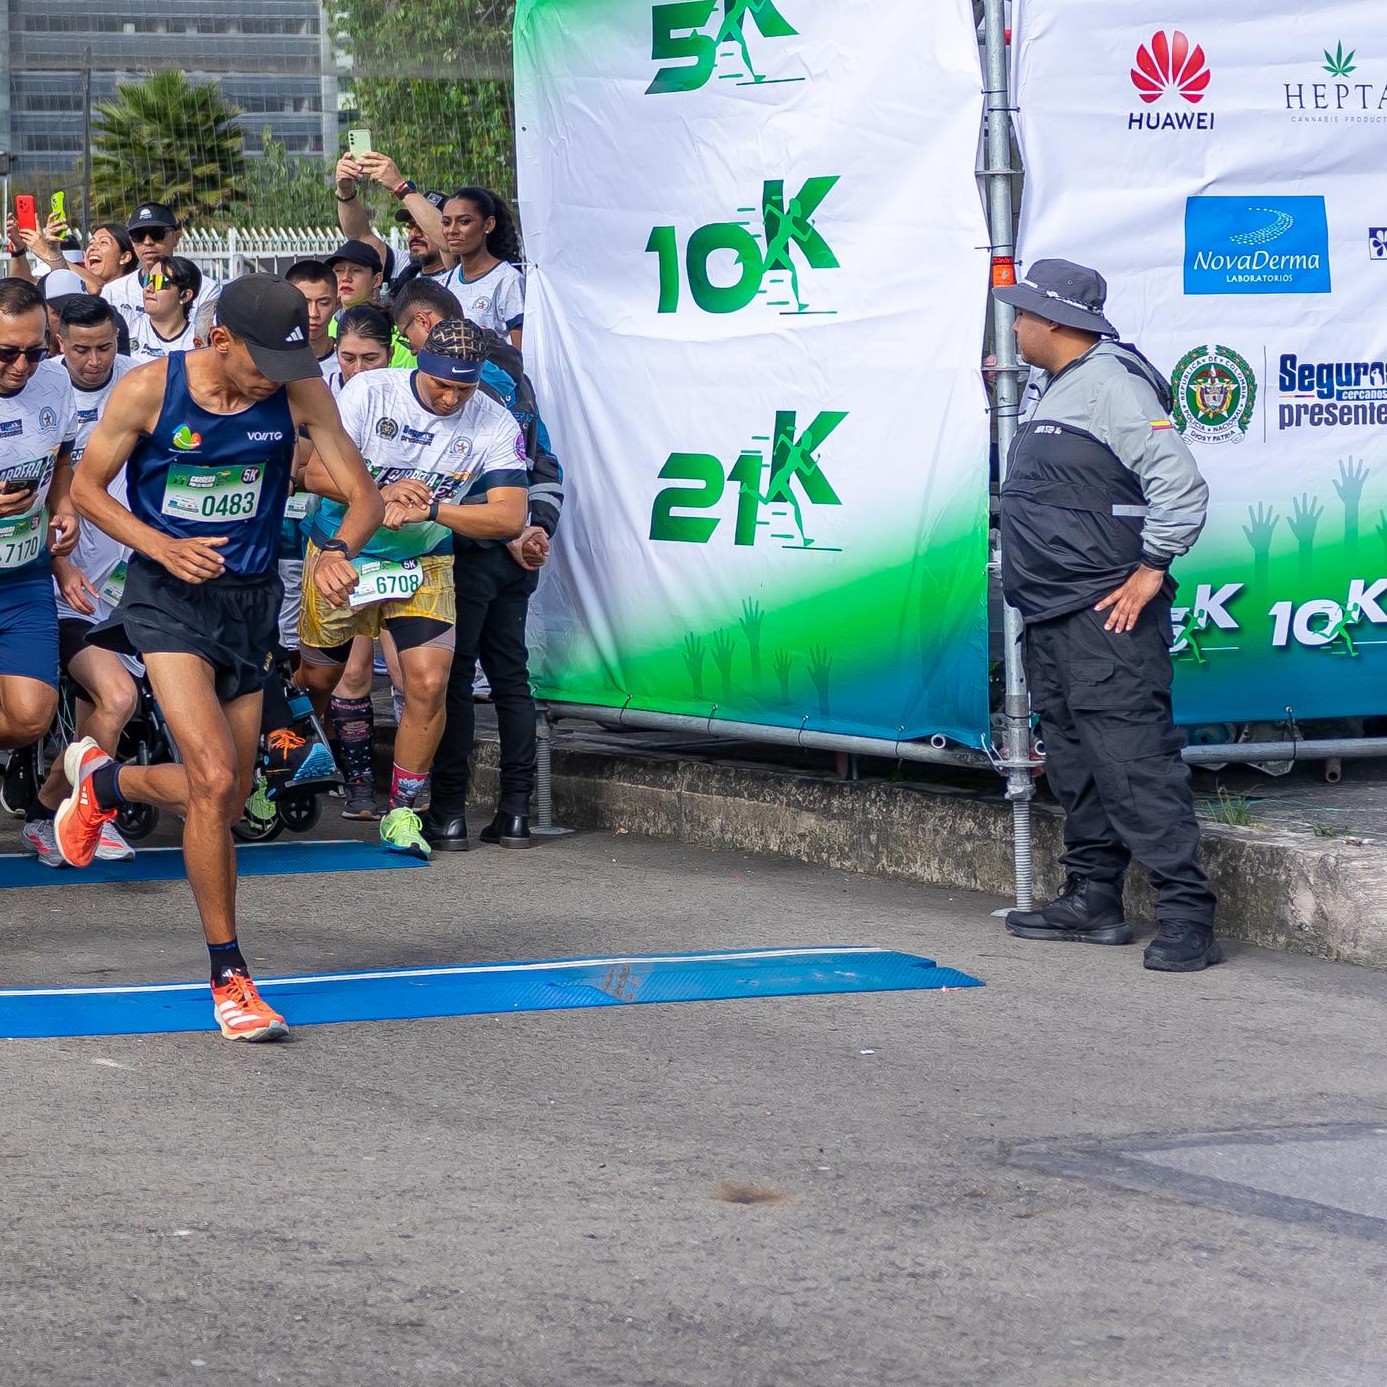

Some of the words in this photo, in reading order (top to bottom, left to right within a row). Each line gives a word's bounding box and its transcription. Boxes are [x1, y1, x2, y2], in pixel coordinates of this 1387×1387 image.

[1128, 112, 1214, 130] HUAWEI
[1291, 116, 1339, 124] CANNABIS
[645, 175, 841, 313] 10K
[1193, 249, 1319, 271] NovaDerma
[1226, 274, 1294, 283] LABORATORIOS
[1225, 360, 1246, 400] COLOMBIA
[1279, 353, 1387, 399] Seguro
[1213, 409, 1242, 432] NACIONAL
[1213, 430, 1235, 442] PATRIA
[243, 469, 259, 481] 5K
[649, 411, 850, 546] 21K
[201, 492, 255, 516] 0483
[6, 536, 38, 563] 7170
[404, 559, 416, 569] 5K
[376, 574, 419, 595] 6708
